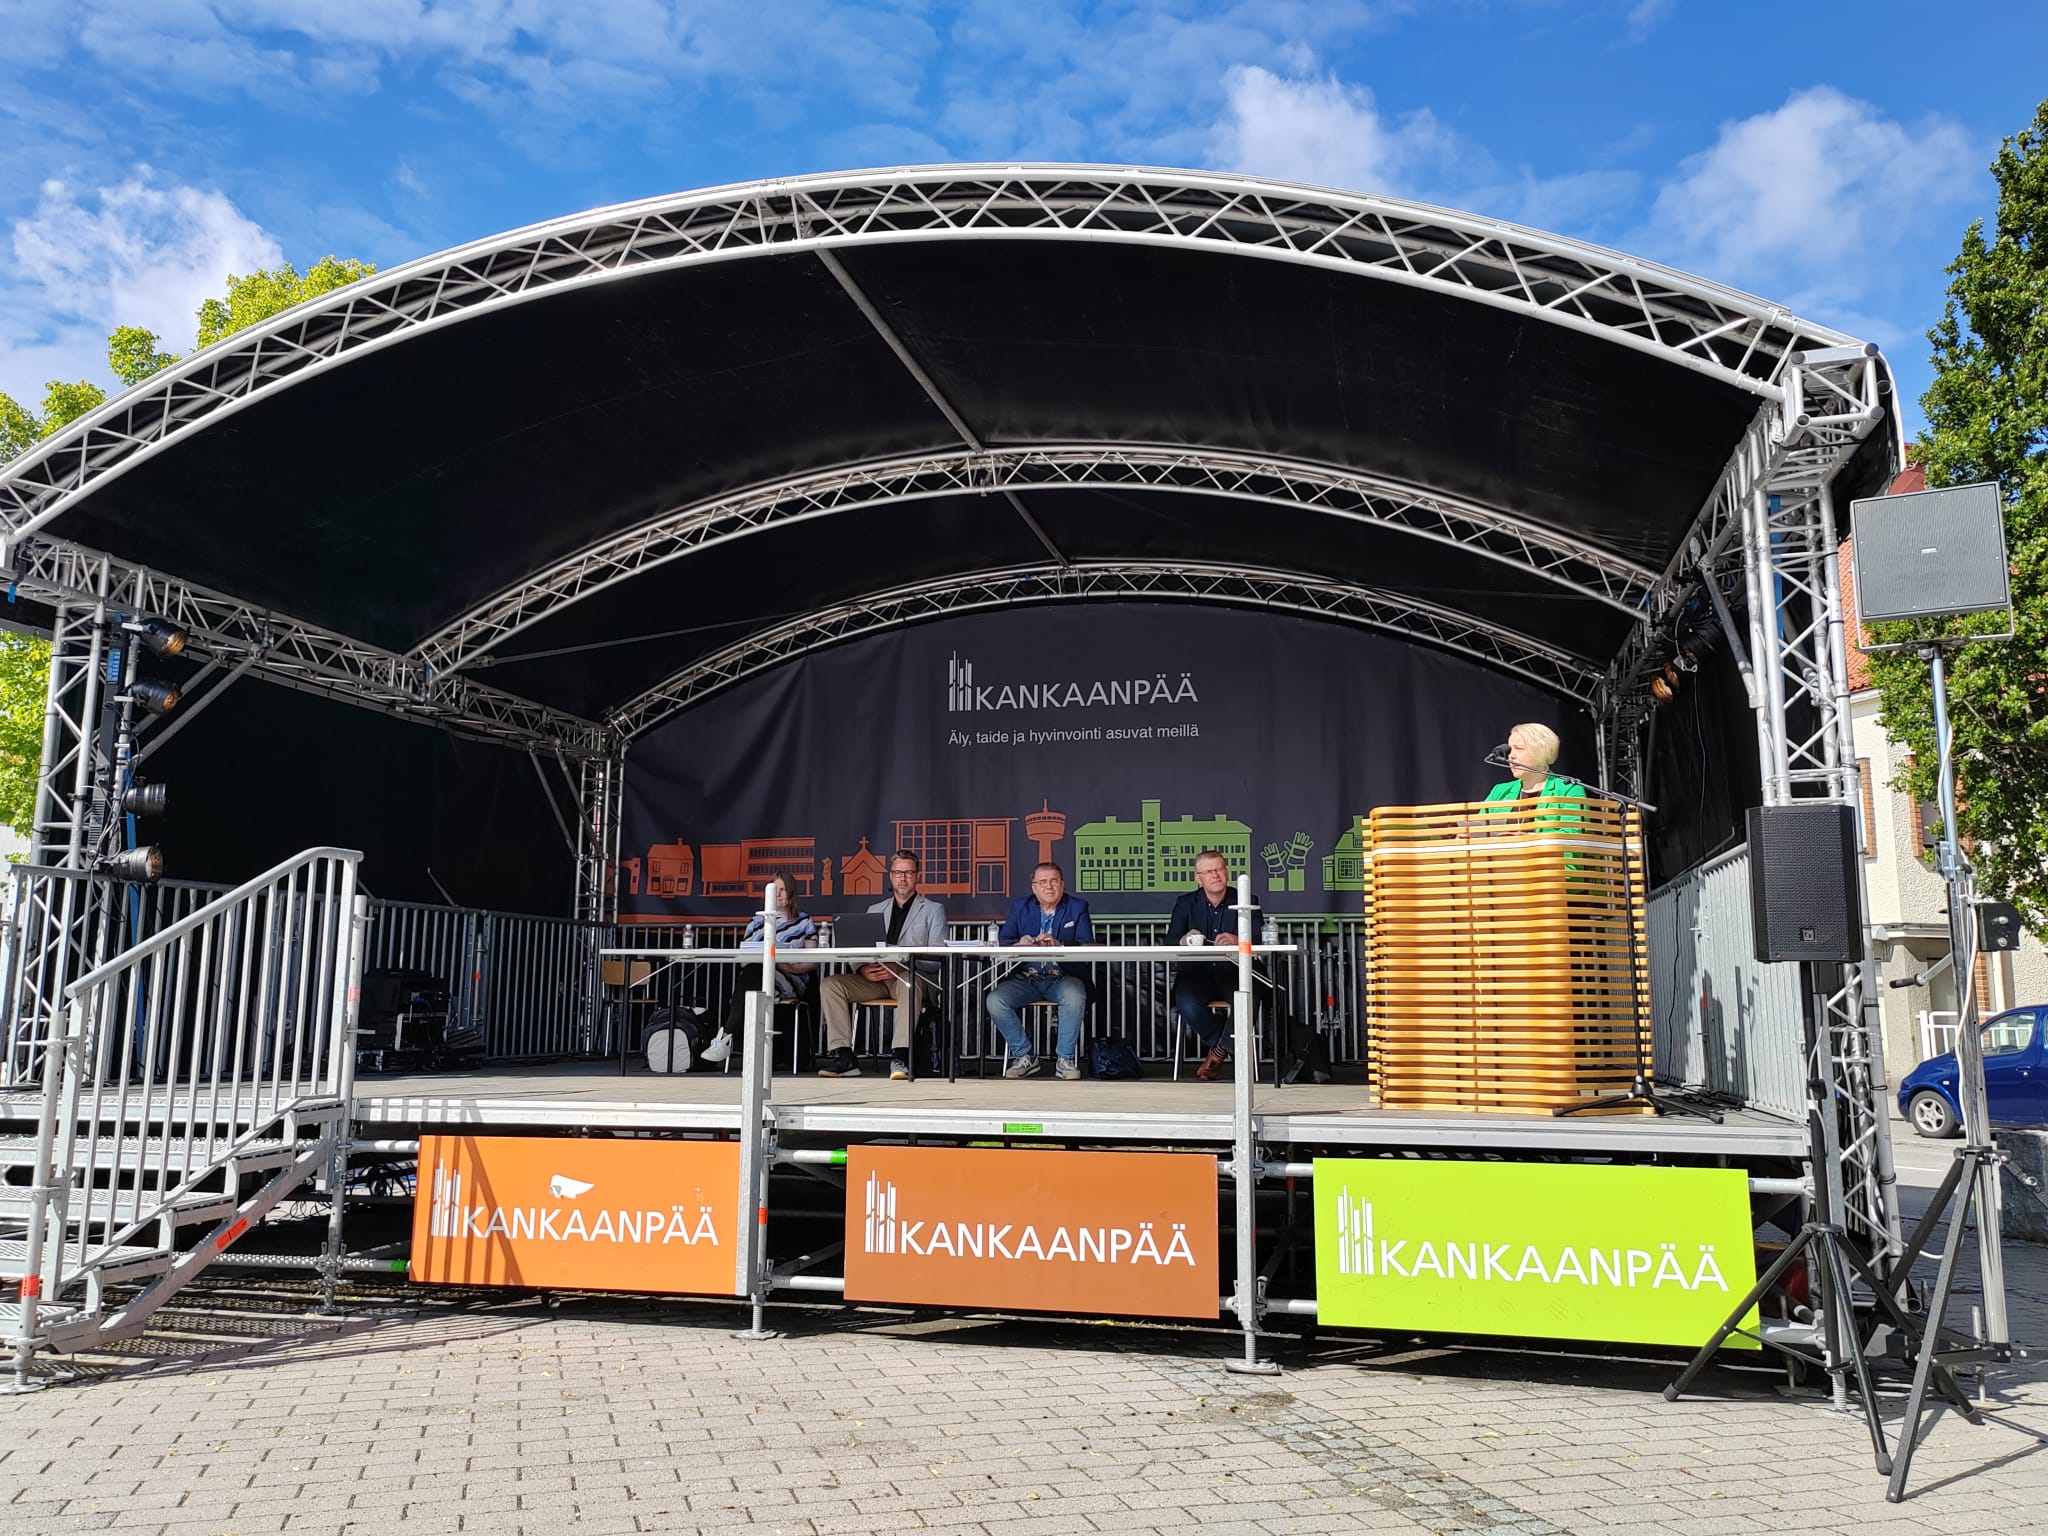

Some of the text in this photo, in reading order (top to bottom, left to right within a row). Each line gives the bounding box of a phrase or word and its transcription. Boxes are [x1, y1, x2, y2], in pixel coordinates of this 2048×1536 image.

[975, 672, 1199, 711] KANKAANPÄÄ
[948, 723, 1200, 748] Äly, taide ja hyvinvointi asuvat meillä
[461, 1205, 720, 1246] KANKAANPÄÄ
[900, 1220, 1196, 1266] KANKAANPÄÄ
[1379, 1239, 1730, 1292] KANKAANPÄÄ
